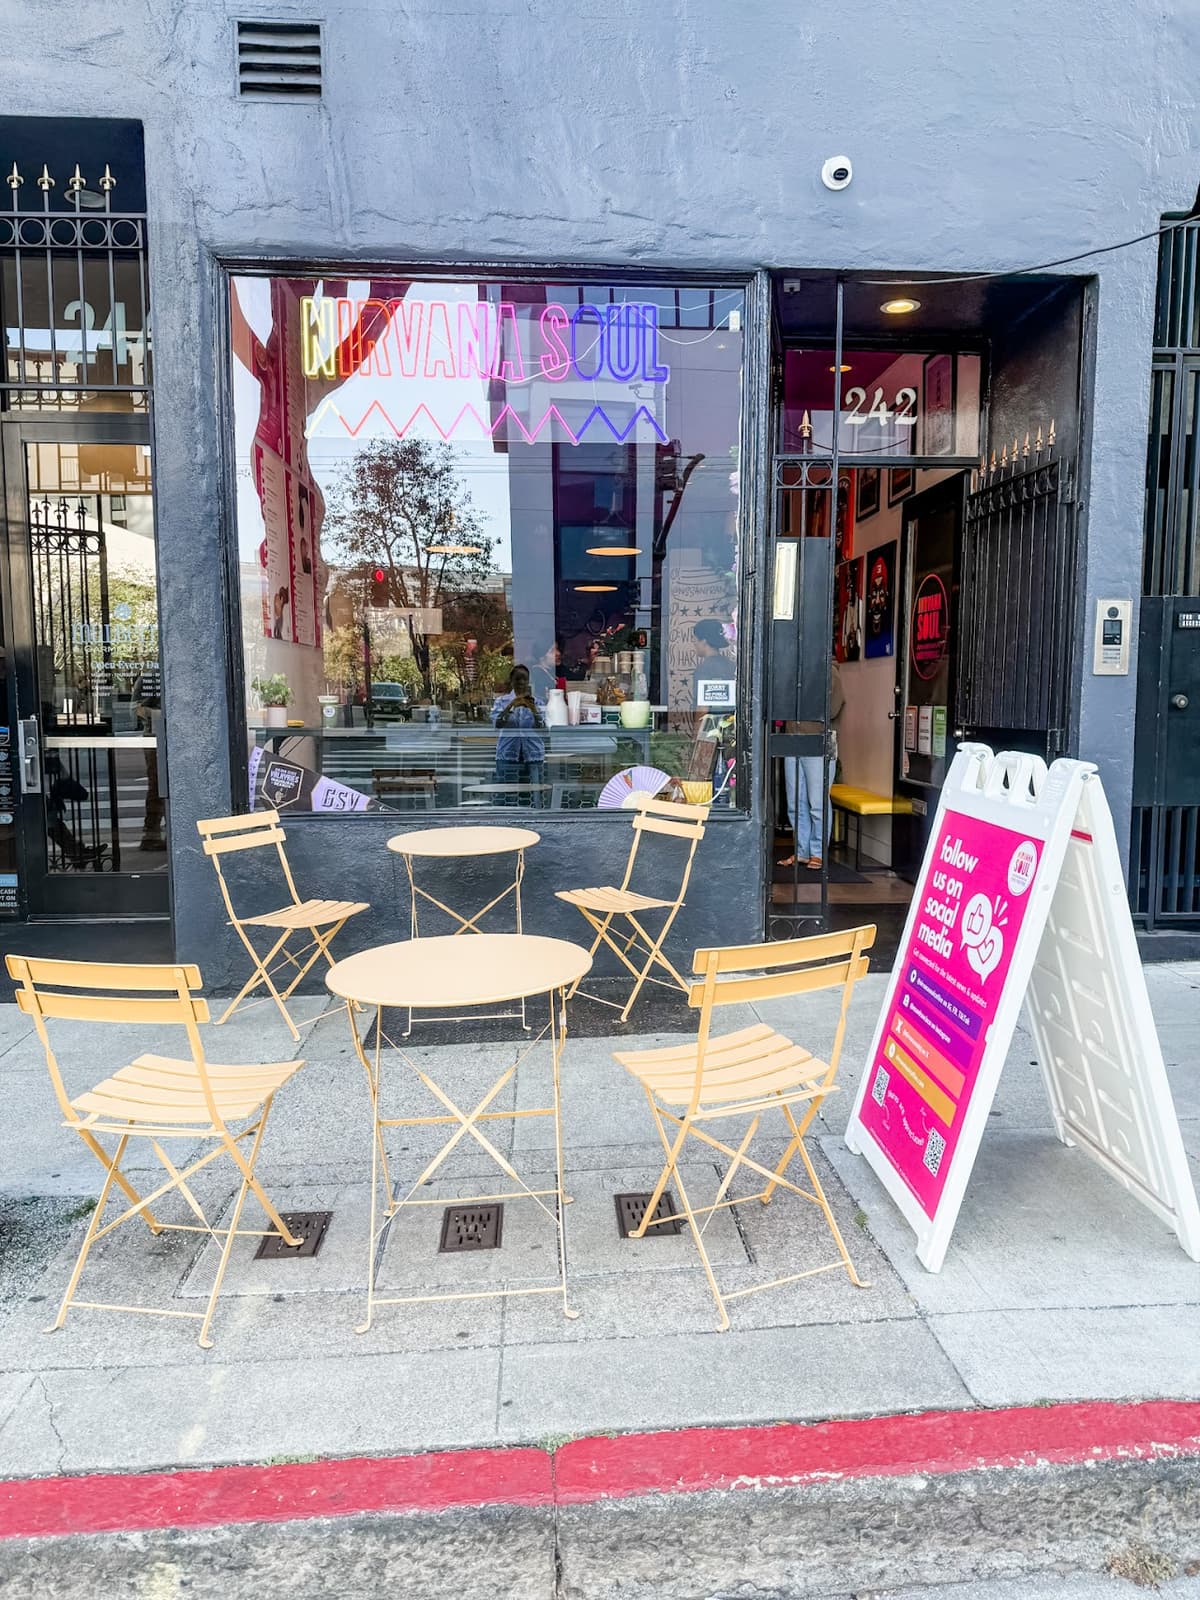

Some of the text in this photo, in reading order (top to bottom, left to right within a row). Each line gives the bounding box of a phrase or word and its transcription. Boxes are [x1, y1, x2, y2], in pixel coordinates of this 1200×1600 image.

[64, 300, 151, 365] 24
[301, 297, 670, 382] NIRVANA SOUL
[844, 387, 918, 426] 242
[917, 611, 940, 640] SOUL
[91, 661, 159, 671] Open Every Da
[322, 788, 360, 811] GSV
[939, 835, 979, 874] follow
[932, 870, 964, 900] us on
[924, 897, 960, 929] social
[917, 922, 954, 960] media
[945, 972, 956, 985] latest
[956, 981, 966, 993] news
[969, 990, 987, 1009] updates
